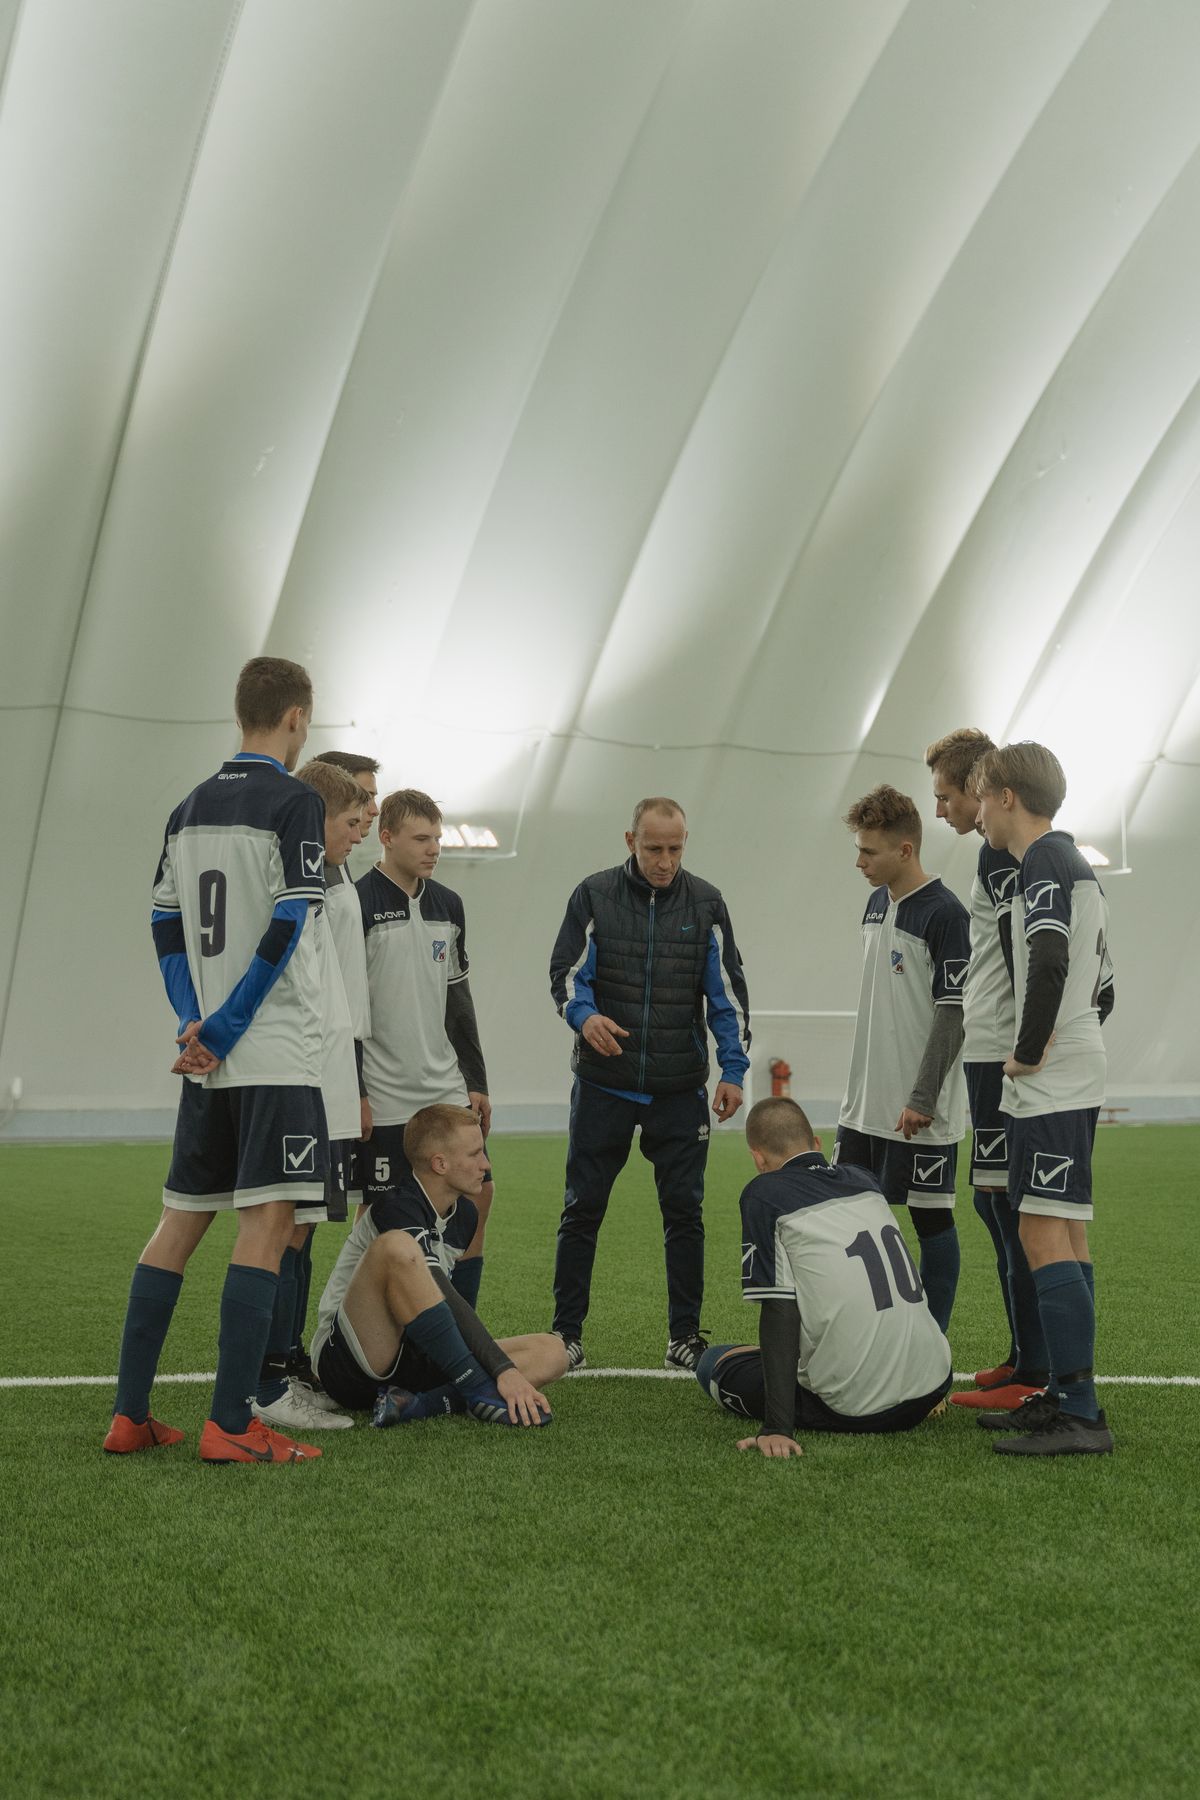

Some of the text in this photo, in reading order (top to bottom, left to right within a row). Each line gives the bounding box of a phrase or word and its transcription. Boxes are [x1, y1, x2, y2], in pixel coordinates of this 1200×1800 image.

[199, 869, 227, 958] 9
[375, 1157, 390, 1182] 5
[844, 1224, 924, 1312] 10
